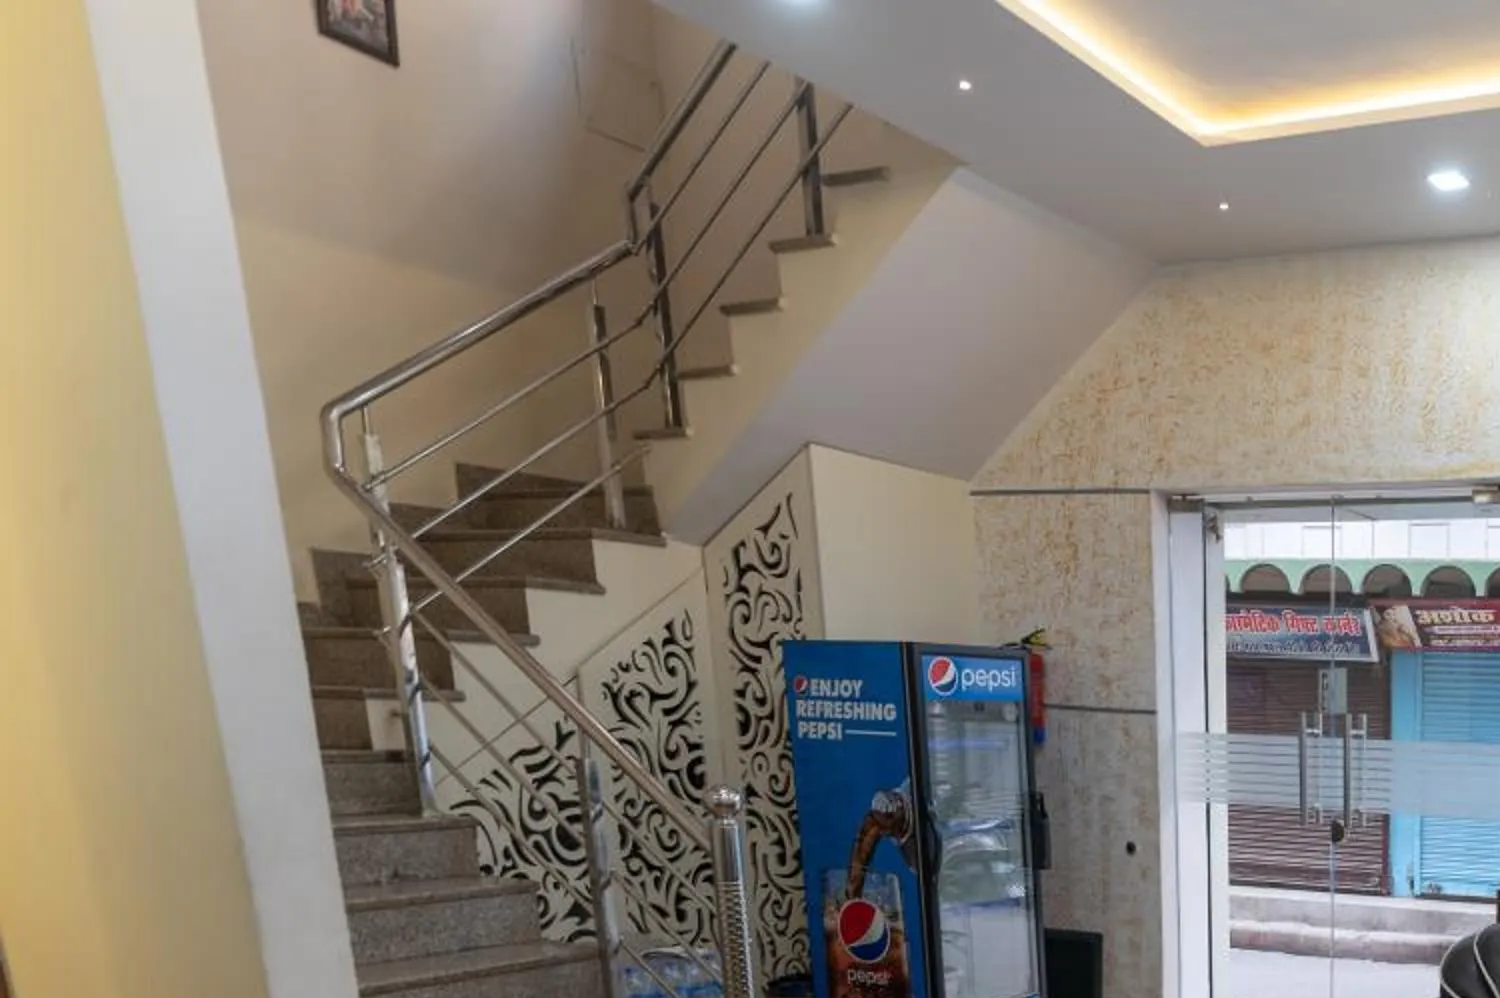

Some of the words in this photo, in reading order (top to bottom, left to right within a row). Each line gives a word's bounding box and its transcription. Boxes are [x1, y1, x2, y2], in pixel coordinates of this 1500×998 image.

[810, 678, 863, 698] ENJOY
[961, 665, 1016, 692] pepsi
[796, 700, 897, 721] REFRESHING
[797, 721, 842, 740] PEPSI
[847, 968, 890, 987] pepsi
